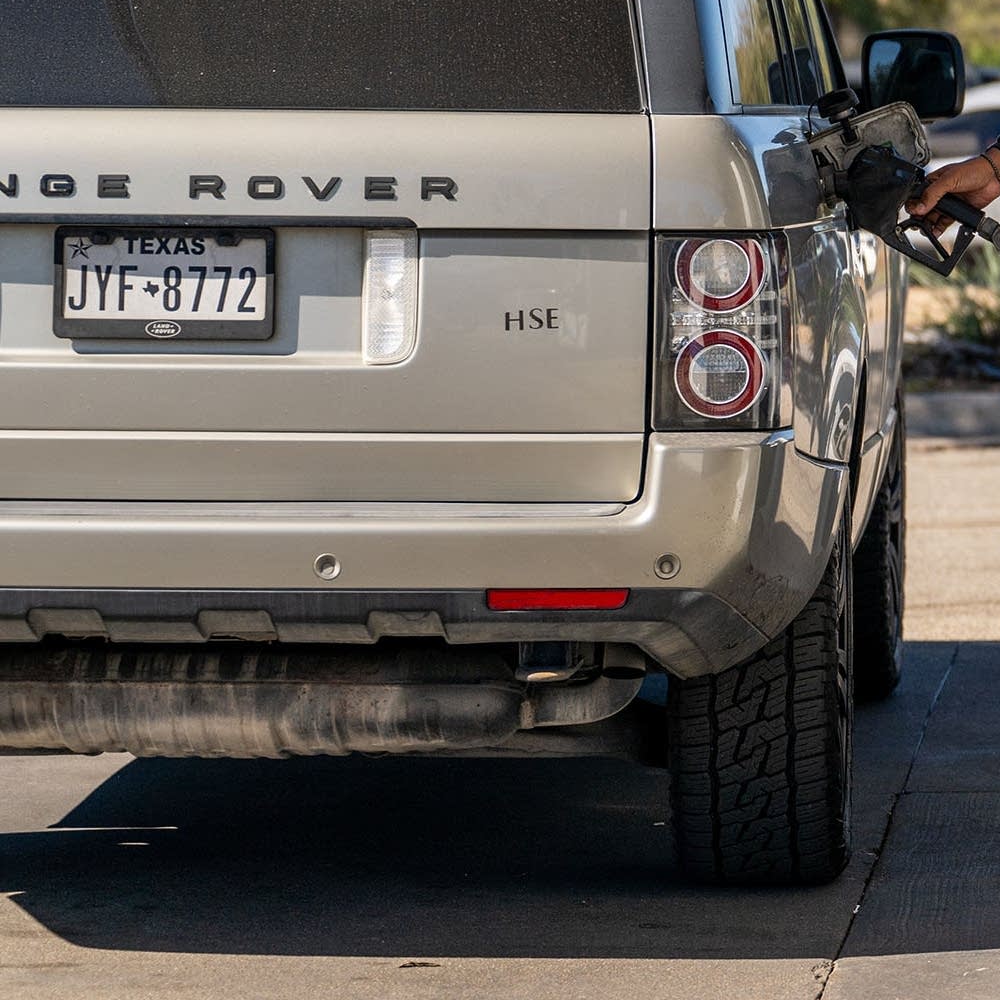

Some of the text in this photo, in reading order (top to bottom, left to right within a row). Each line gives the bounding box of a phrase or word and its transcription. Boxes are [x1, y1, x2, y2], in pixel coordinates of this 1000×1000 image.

[189, 174, 458, 201] ROVER
[123, 237, 206, 255] TEXAS
[68, 264, 257, 313] JYF 8772
[505, 307, 559, 331] HSE
